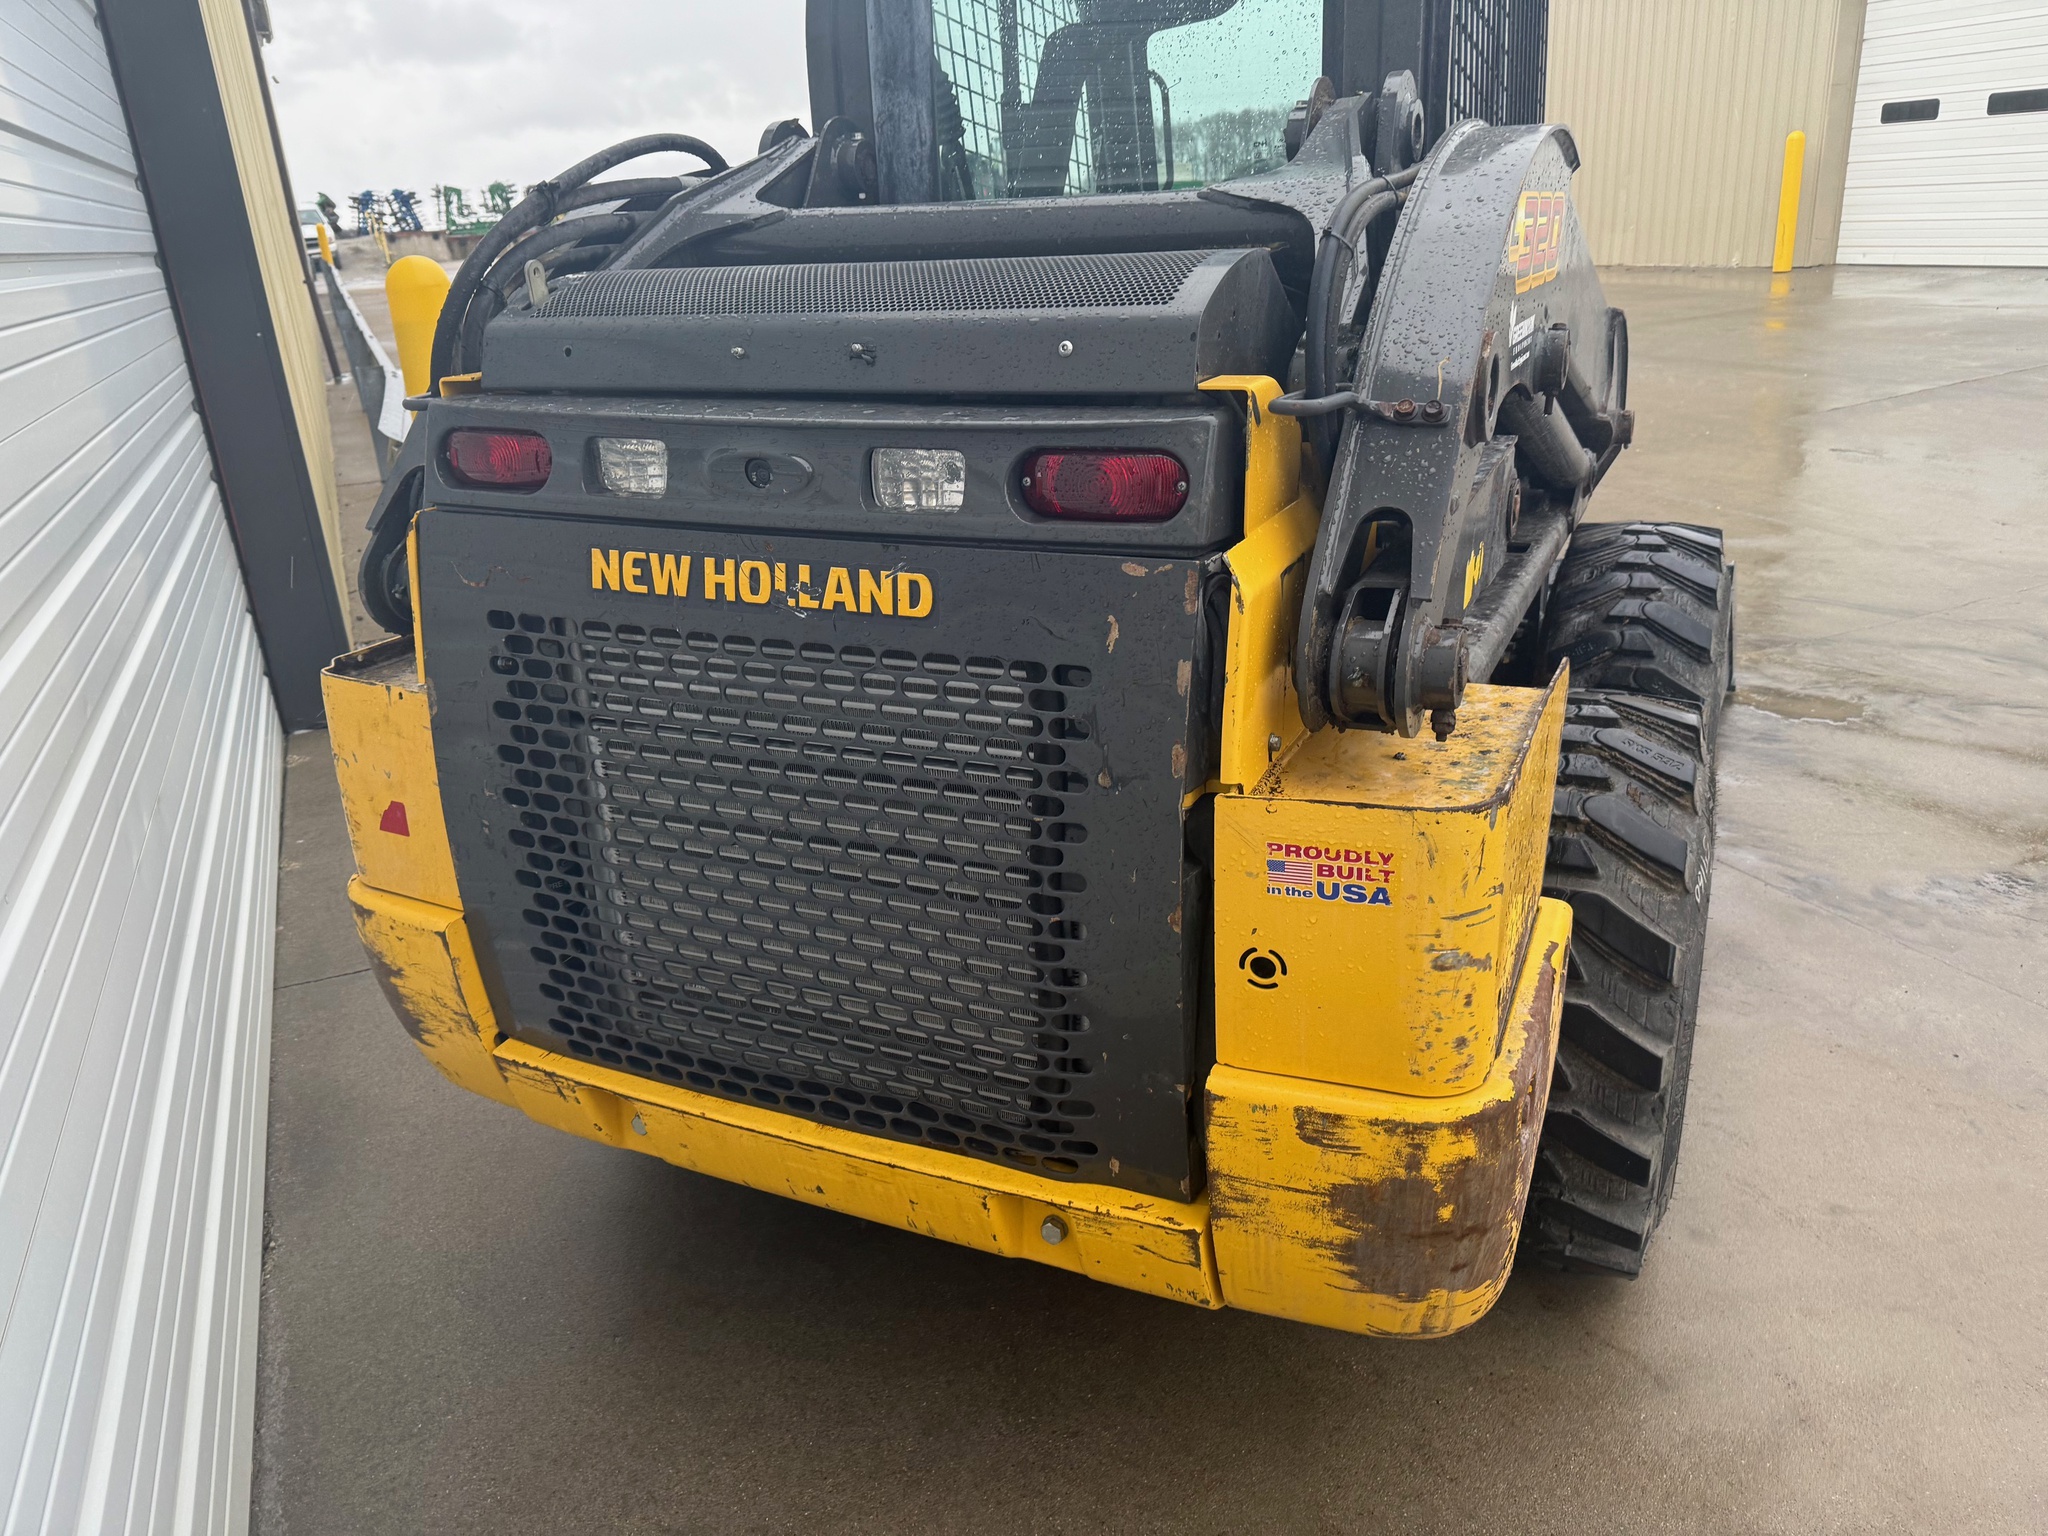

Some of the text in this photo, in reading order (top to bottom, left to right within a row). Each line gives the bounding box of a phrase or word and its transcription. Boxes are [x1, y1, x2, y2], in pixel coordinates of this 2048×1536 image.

[590, 547, 934, 618] NEW HOLLAND
[1266, 842, 1395, 867] PROUDLY
[1316, 863, 1395, 884] BUILT
[1266, 881, 1393, 907] in the USA
